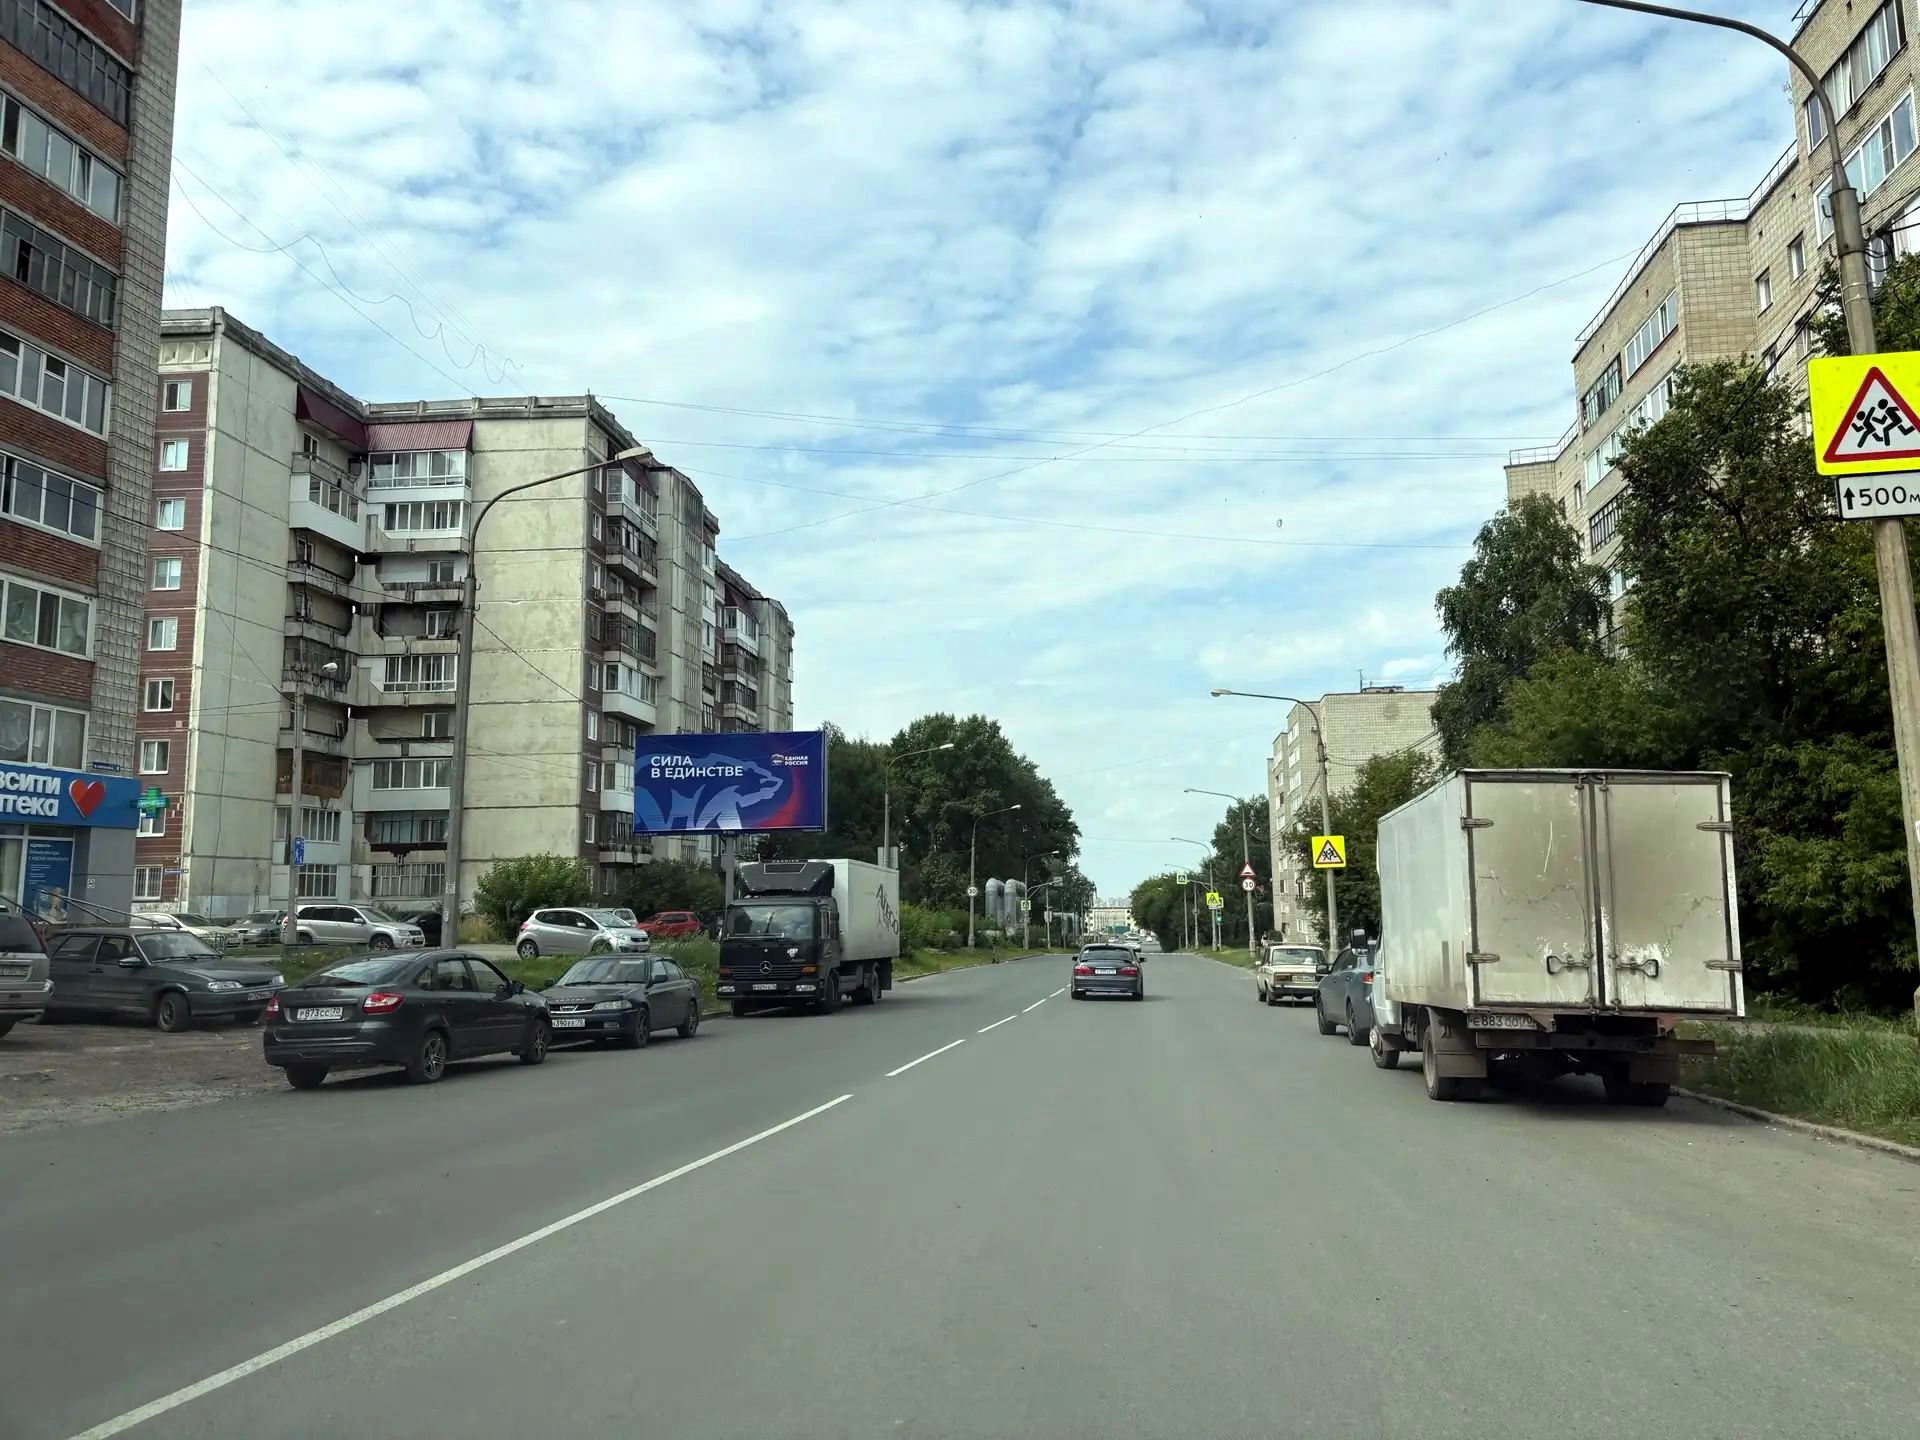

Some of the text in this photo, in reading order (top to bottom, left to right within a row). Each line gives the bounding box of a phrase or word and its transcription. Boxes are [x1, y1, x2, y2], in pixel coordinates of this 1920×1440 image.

[651, 755, 693, 767] СИЛА
[651, 766, 744, 780] В ЕДИНСТВЕ
[0, 794, 59, 817] тека
